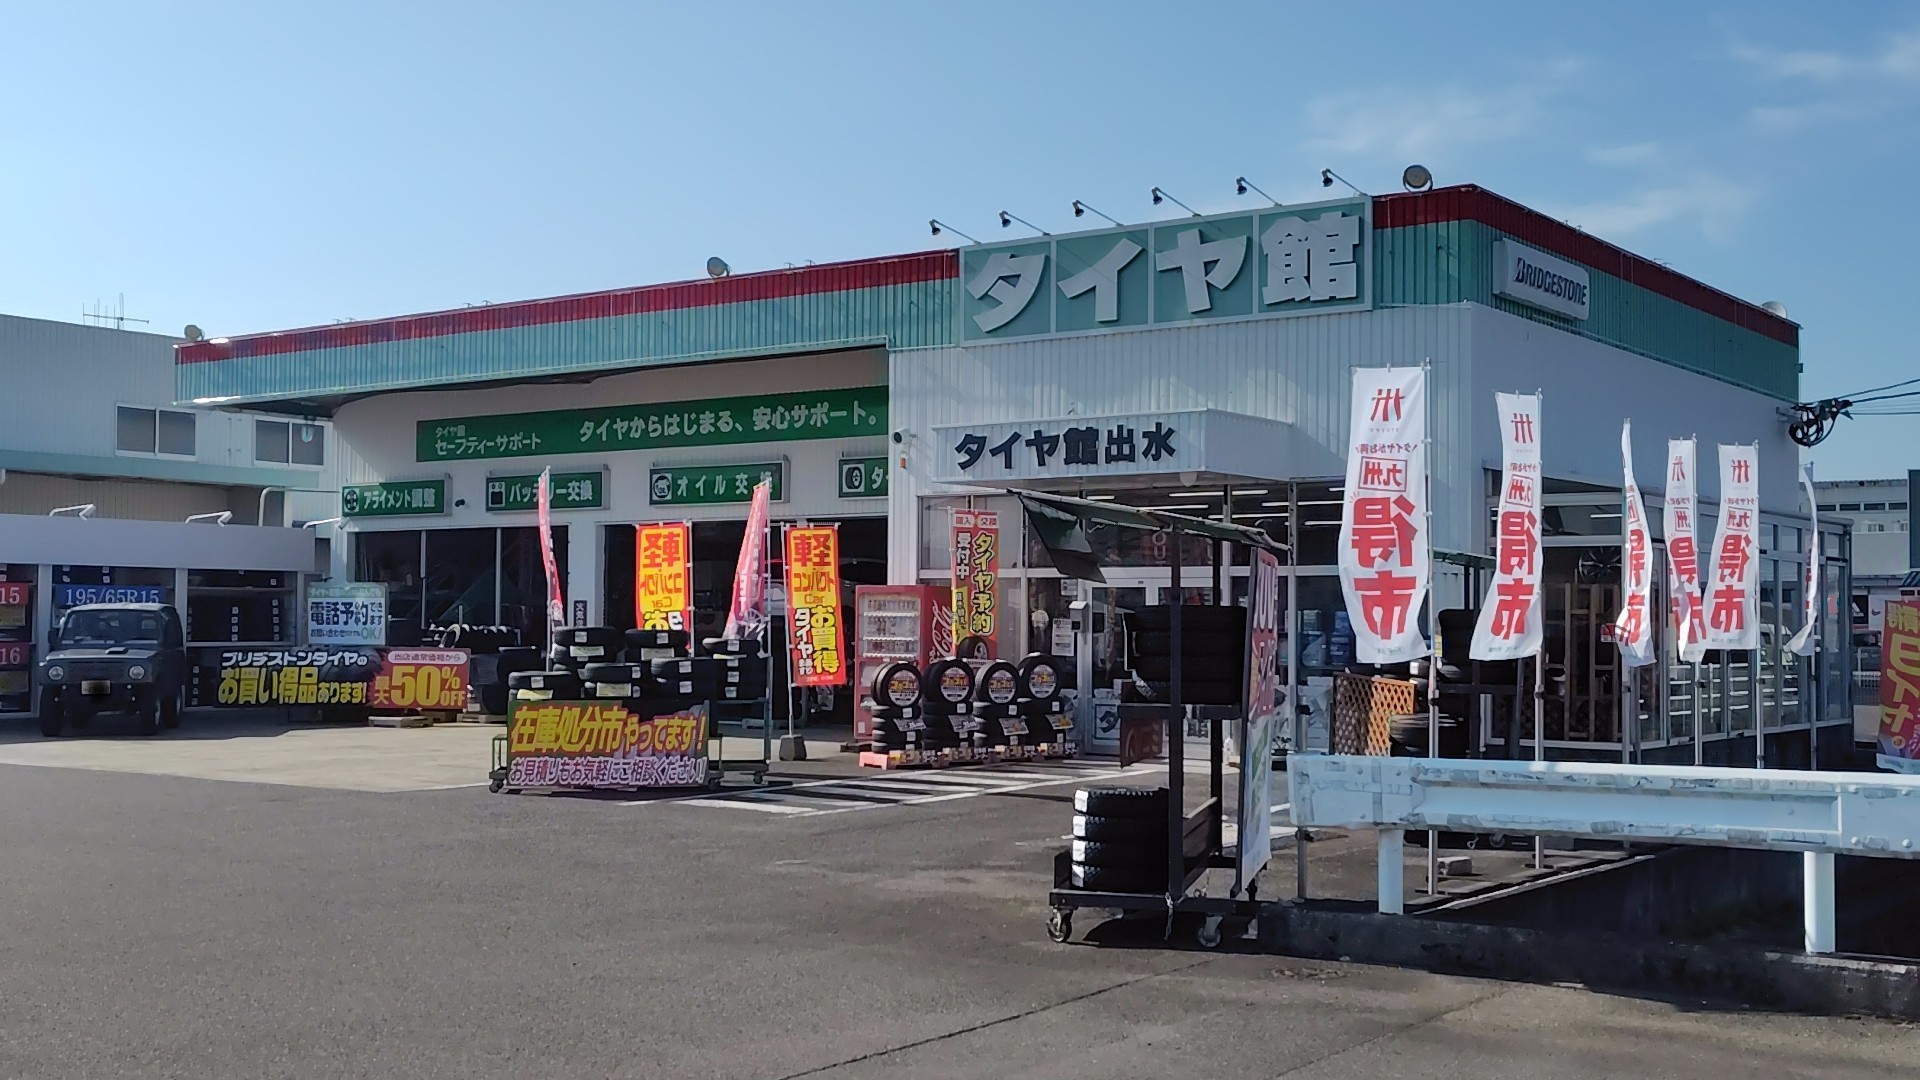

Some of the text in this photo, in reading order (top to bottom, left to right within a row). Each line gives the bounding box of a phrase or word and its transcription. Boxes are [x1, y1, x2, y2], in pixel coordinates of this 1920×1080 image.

[966, 210, 1361, 333] タイヤ館
[1513, 257, 1587, 306] BRIDGESTONE
[435, 432, 541, 456] セーフティーサポート
[955, 421, 1177, 470] タイヤ館出水
[793, 533, 831, 567] 軽
[956, 532, 971, 580] 受付中
[66, 588, 160, 605] 195/65R15
[804, 593, 825, 605] Car
[972, 532, 993, 634] タイヤ予約
[440, 690, 466, 706] OFF
[511, 706, 707, 753] 在庫処分市やってます!
